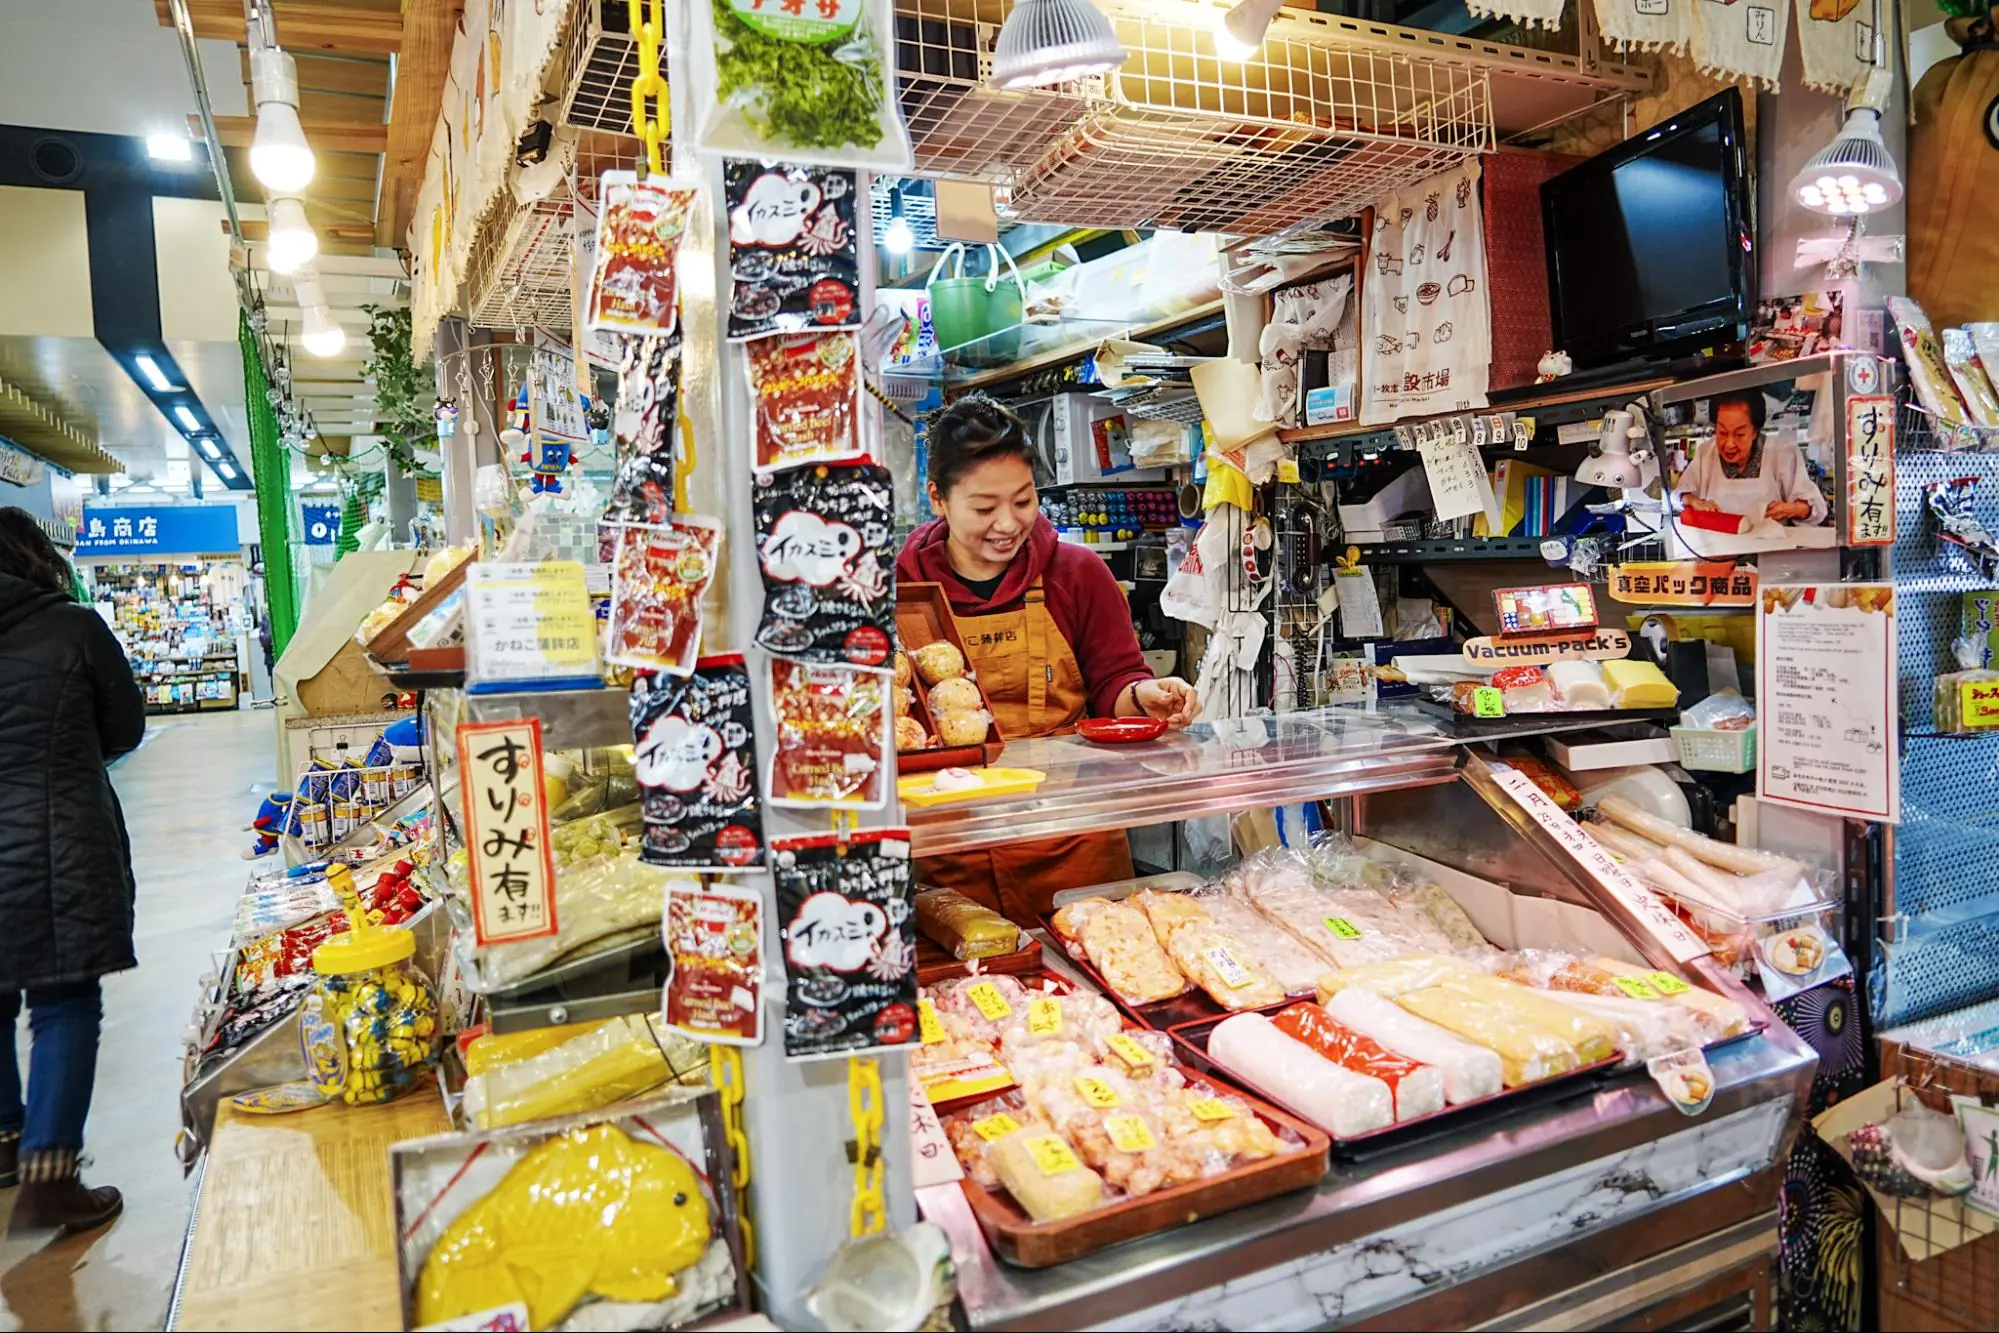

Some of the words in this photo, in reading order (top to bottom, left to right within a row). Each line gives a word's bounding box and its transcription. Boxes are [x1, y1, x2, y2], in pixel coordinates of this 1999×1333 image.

[1517, 438, 1526, 449] 10
[118, 538, 159, 546] OKINAWA
[769, 535, 835, 564] イカスミ
[1617, 574, 1752, 597] 真空パック商品
[1466, 634, 1628, 660] Vacuum-pack's
